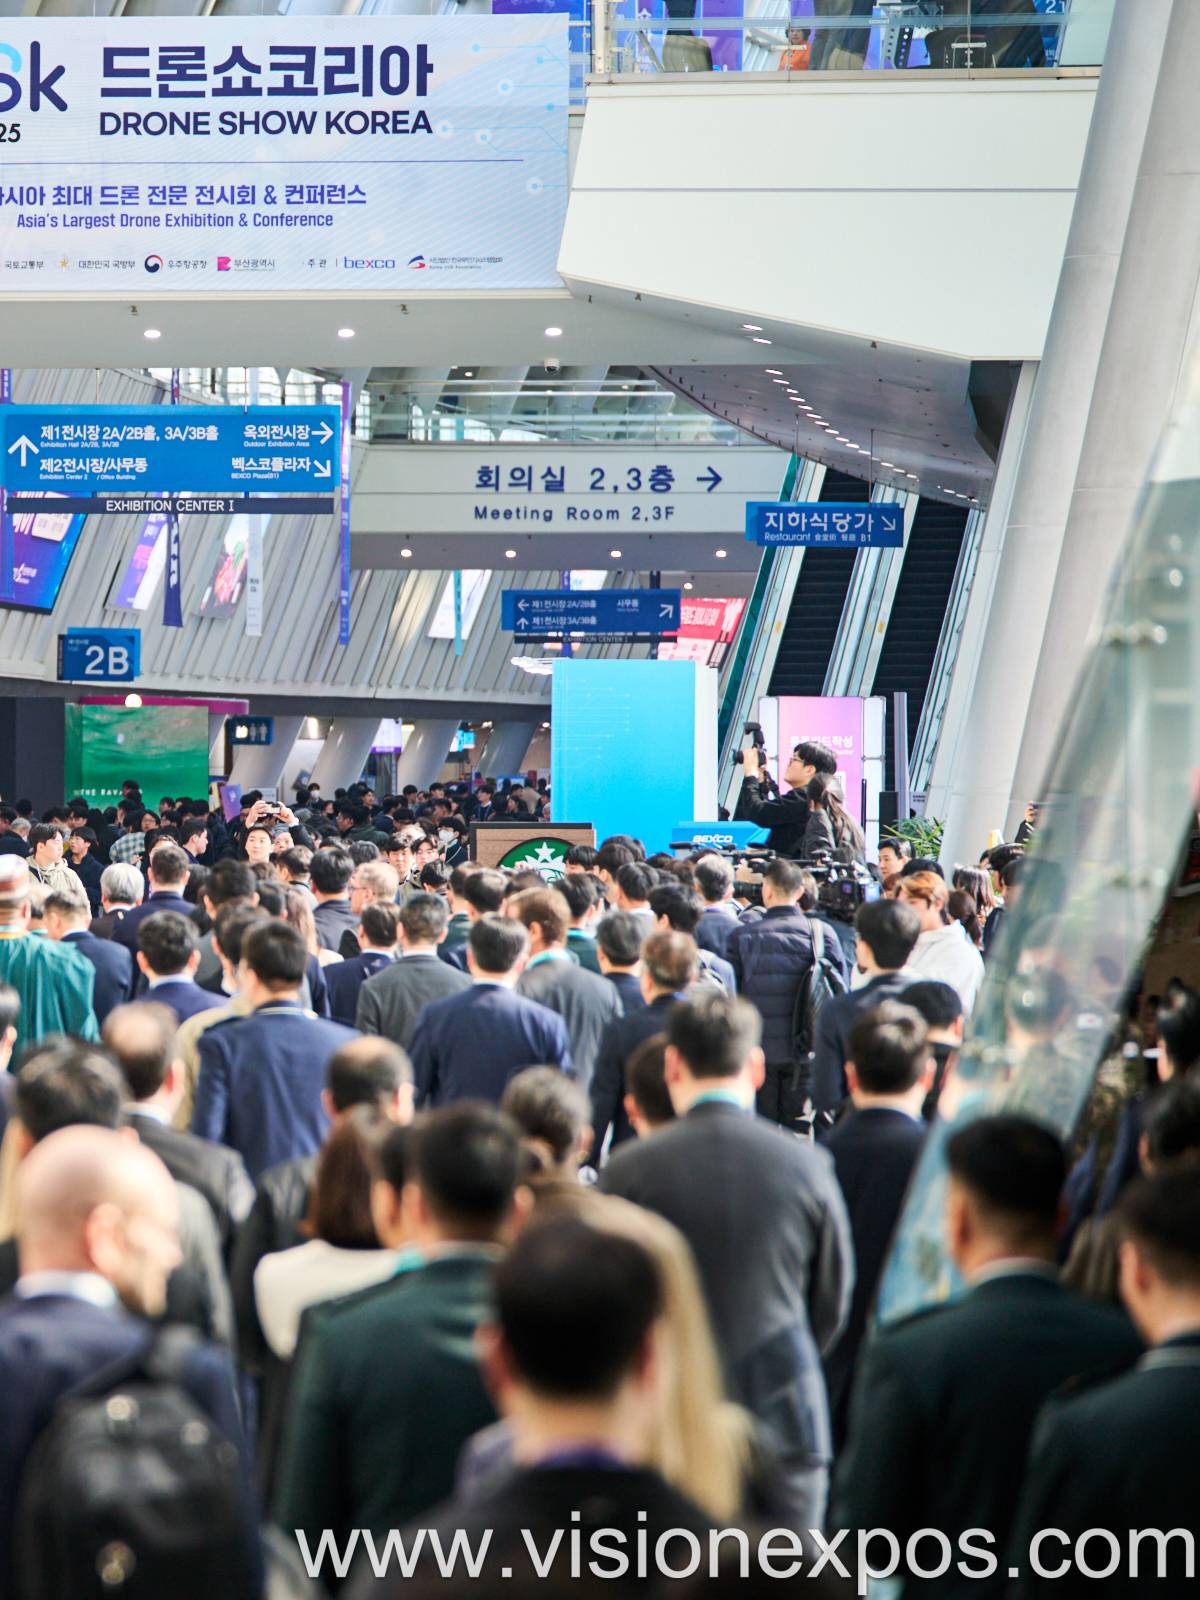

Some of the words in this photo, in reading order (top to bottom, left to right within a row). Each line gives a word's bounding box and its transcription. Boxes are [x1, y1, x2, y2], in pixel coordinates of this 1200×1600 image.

[99, 43, 434, 99] 드론쇼코리아
[99, 111, 211, 136] DRONE
[218, 111, 317, 136] SHOW
[325, 110, 434, 136] KOREA
[52, 185, 93, 206] 최대
[99, 185, 140, 206] 드론
[147, 185, 188, 206] 전문
[194, 185, 256, 206] 전시회
[263, 185, 278, 206] &
[284, 185, 367, 206] 컨퍼런스
[63, 214, 116, 230] Largest
[120, 213, 161, 227] Drone
[165, 213, 234, 227] Exhibition
[238, 213, 248, 227] &
[253, 212, 334, 227] Conference
[4, 260, 44, 270] 국토교통부
[78, 260, 110, 269] 대한민국
[234, 258, 275, 268] 부산광역시
[344, 256, 395, 269] bexco
[41, 424, 100, 441] 제1전시장
[102, 425, 160, 441] 2A/2B홀,
[165, 425, 219, 441] 3A/3B홀
[243, 424, 310, 440] 옥외전시장
[40, 456, 148, 473] 제2전시장/사무동
[231, 456, 312, 472] 벡스코플라자
[475, 465, 566, 492] 회의실
[590, 465, 675, 494] 2,3층
[106, 499, 172, 512] EXHIBITION
[176, 499, 225, 512] CENTER
[474, 505, 553, 522] Meeting
[567, 506, 619, 520] Room
[632, 505, 675, 523] 2,3F
[765, 511, 874, 533] 지하식당가
[764, 532, 811, 541] Restaurant
[84, 645, 130, 676] 2B
[692, 834, 734, 843] BEXCO
